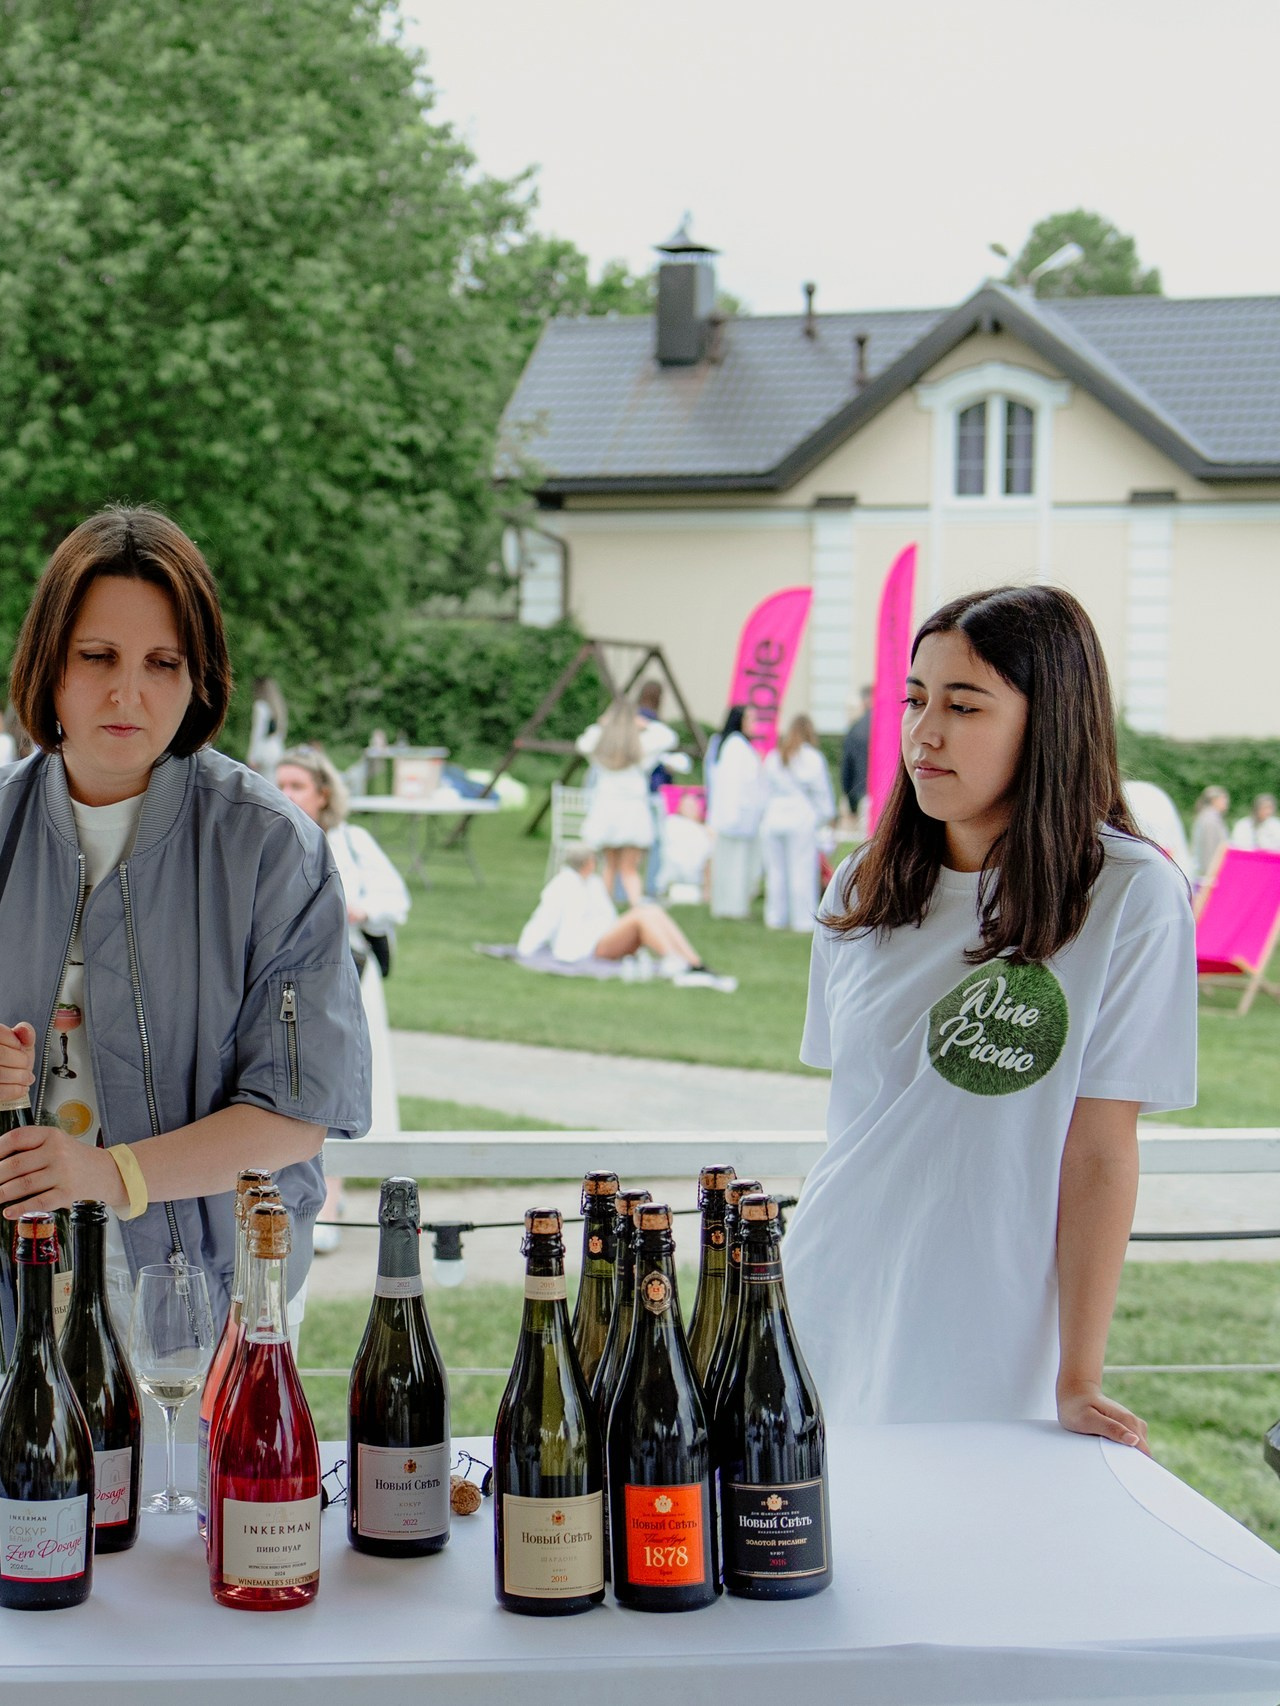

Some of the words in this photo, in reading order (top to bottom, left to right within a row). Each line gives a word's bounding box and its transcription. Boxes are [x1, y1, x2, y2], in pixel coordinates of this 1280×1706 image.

[960, 976, 1040, 1027] Wine
[939, 1016, 1034, 1073] Picnic
[402, 1518, 418, 1526] 2022
[243, 1522, 312, 1535] INKERMAN
[745, 1538, 776, 1546] ЗОЛОТОЙ
[778, 1537, 808, 1546] РИСЛИНГ
[5, 1544, 36, 1562] Zero
[37, 1536, 82, 1558] Dosage
[282, 1544, 302, 1553] НУАР
[643, 1545, 689, 1568] 1878
[238, 1577, 284, 1586] WINEMAKER'S
[285, 1575, 314, 1585] SELECTION
[551, 1575, 568, 1583] 2019
